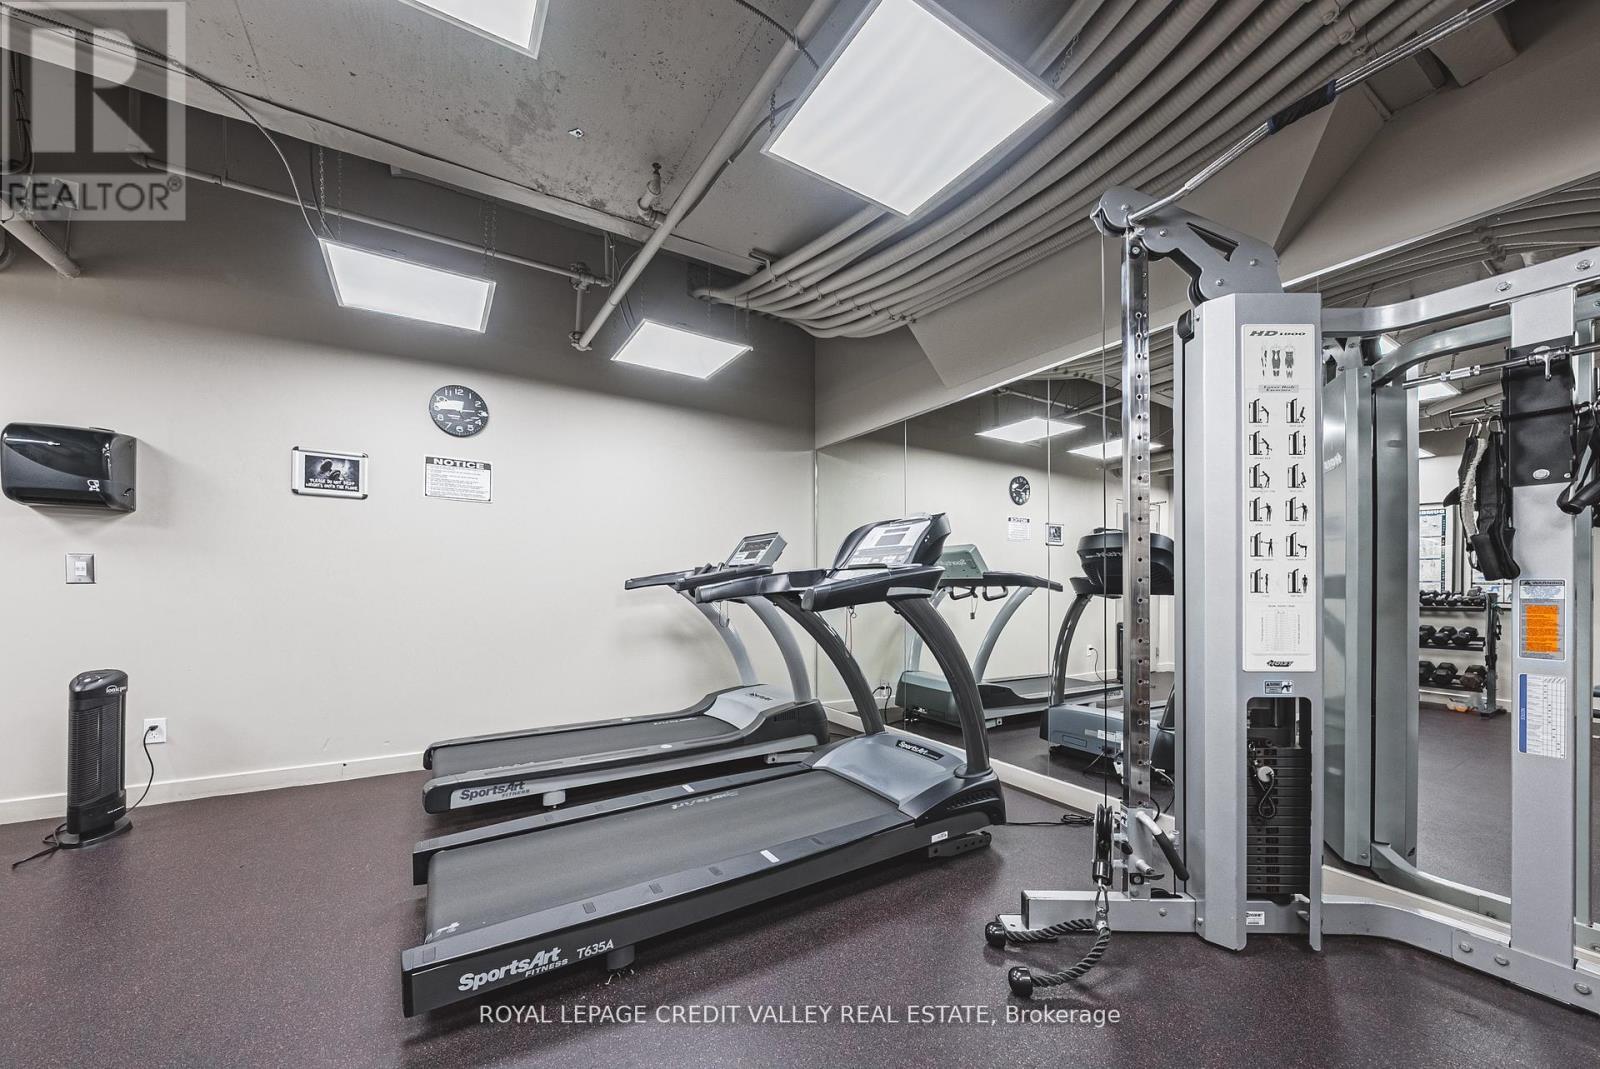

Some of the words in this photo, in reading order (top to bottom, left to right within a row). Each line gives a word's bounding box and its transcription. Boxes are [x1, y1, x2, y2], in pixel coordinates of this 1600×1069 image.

[454, 388, 464, 396] 12
[474, 400, 481, 408] 2
[445, 421, 453, 430] 7
[456, 425, 464, 433] 6
[433, 458, 485, 470] NOTICE
[460, 781, 526, 801] SportsArt
[458, 947, 562, 991] SportsArt
[577, 939, 615, 959] T635A
[525, 959, 569, 978] FITNESS
